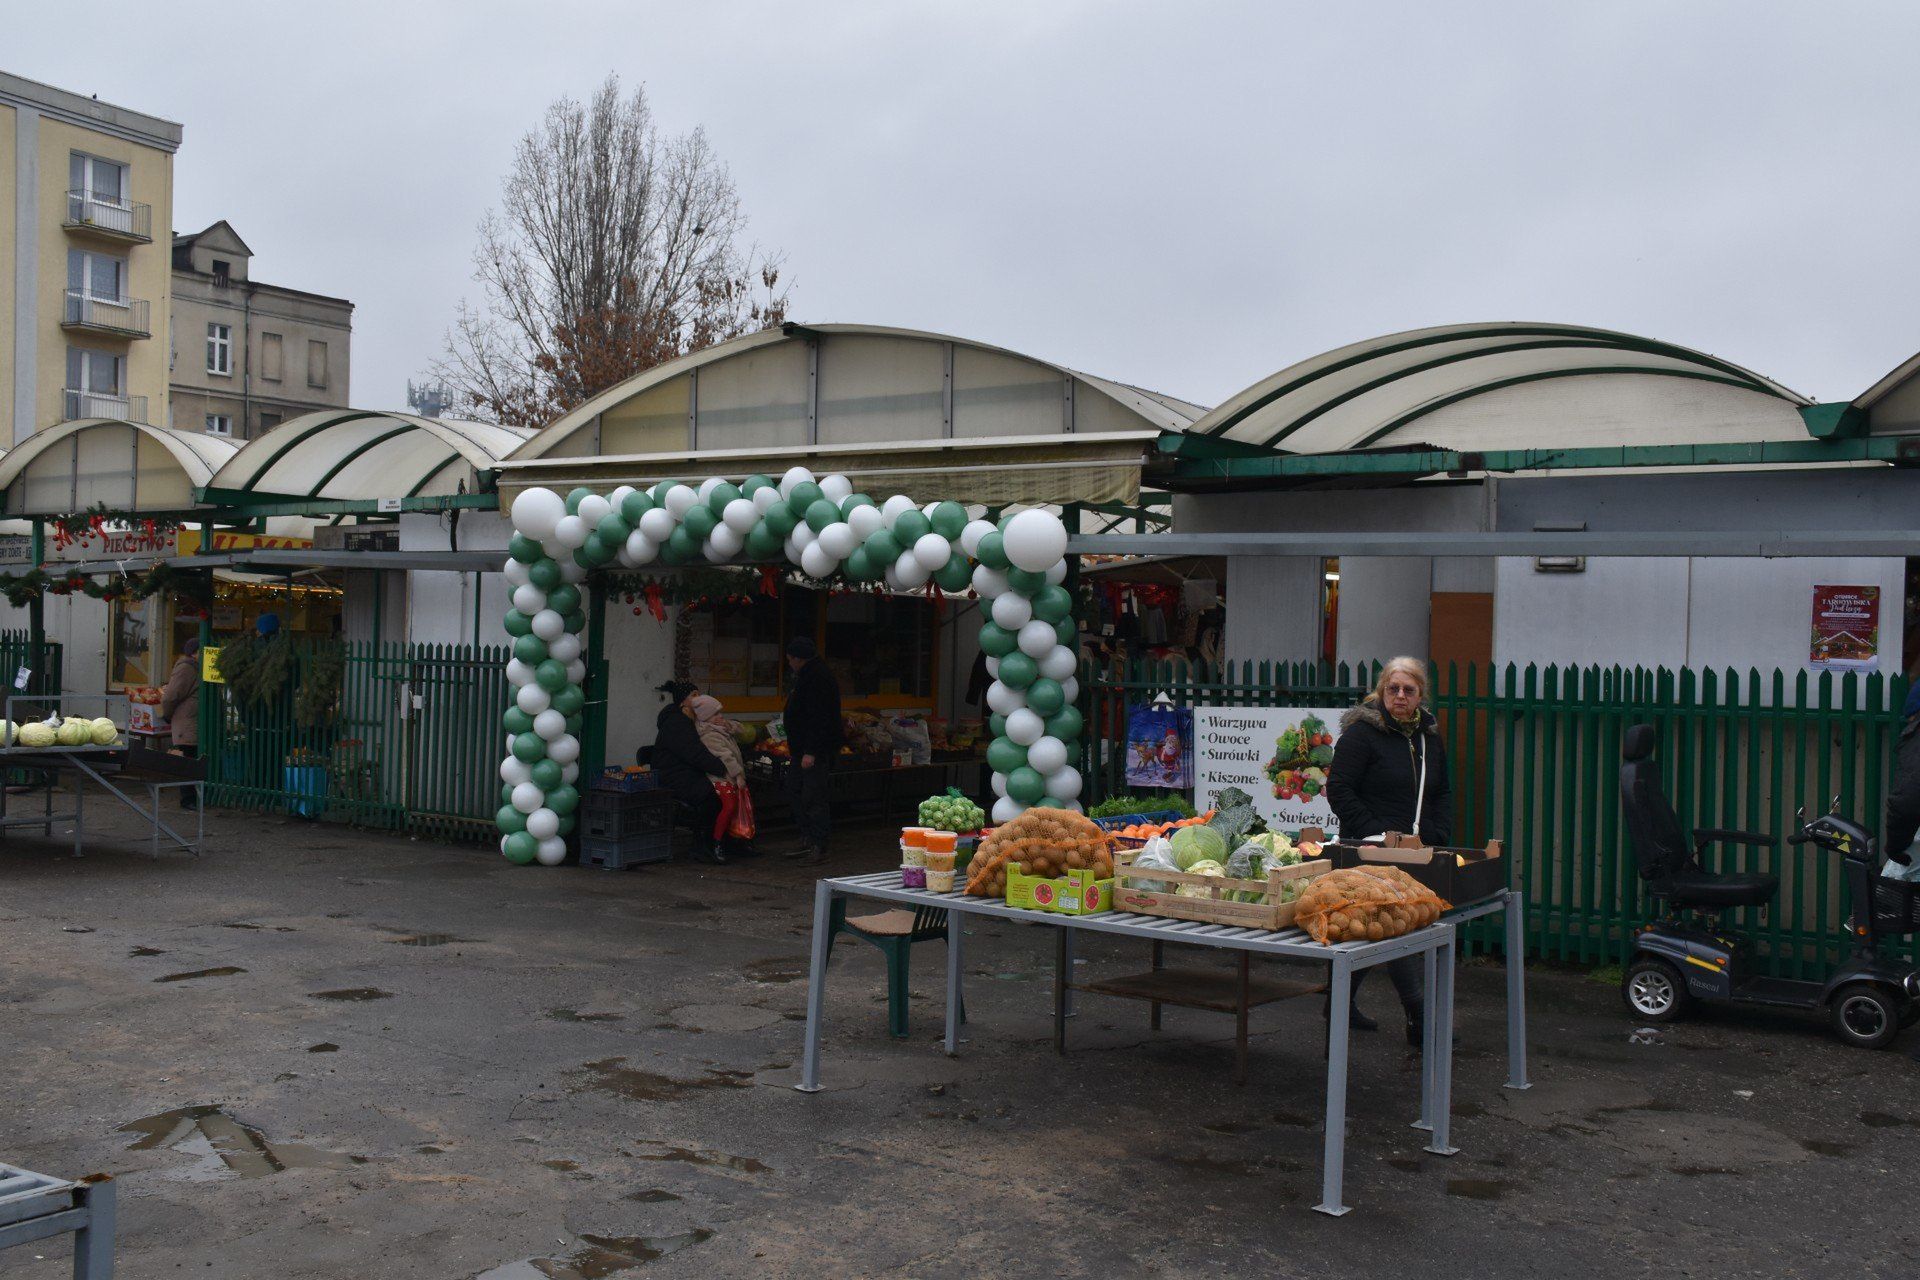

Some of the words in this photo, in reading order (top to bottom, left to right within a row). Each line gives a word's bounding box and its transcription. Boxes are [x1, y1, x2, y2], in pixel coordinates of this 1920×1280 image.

[1208, 715, 1267, 731] Warzywa
[1208, 732, 1251, 745] Owoce
[1207, 748, 1260, 761] Surówki
[1208, 771, 1259, 784] Kiszone:
[1279, 808, 1323, 825] Świeże
[1325, 815, 1340, 828] ja
